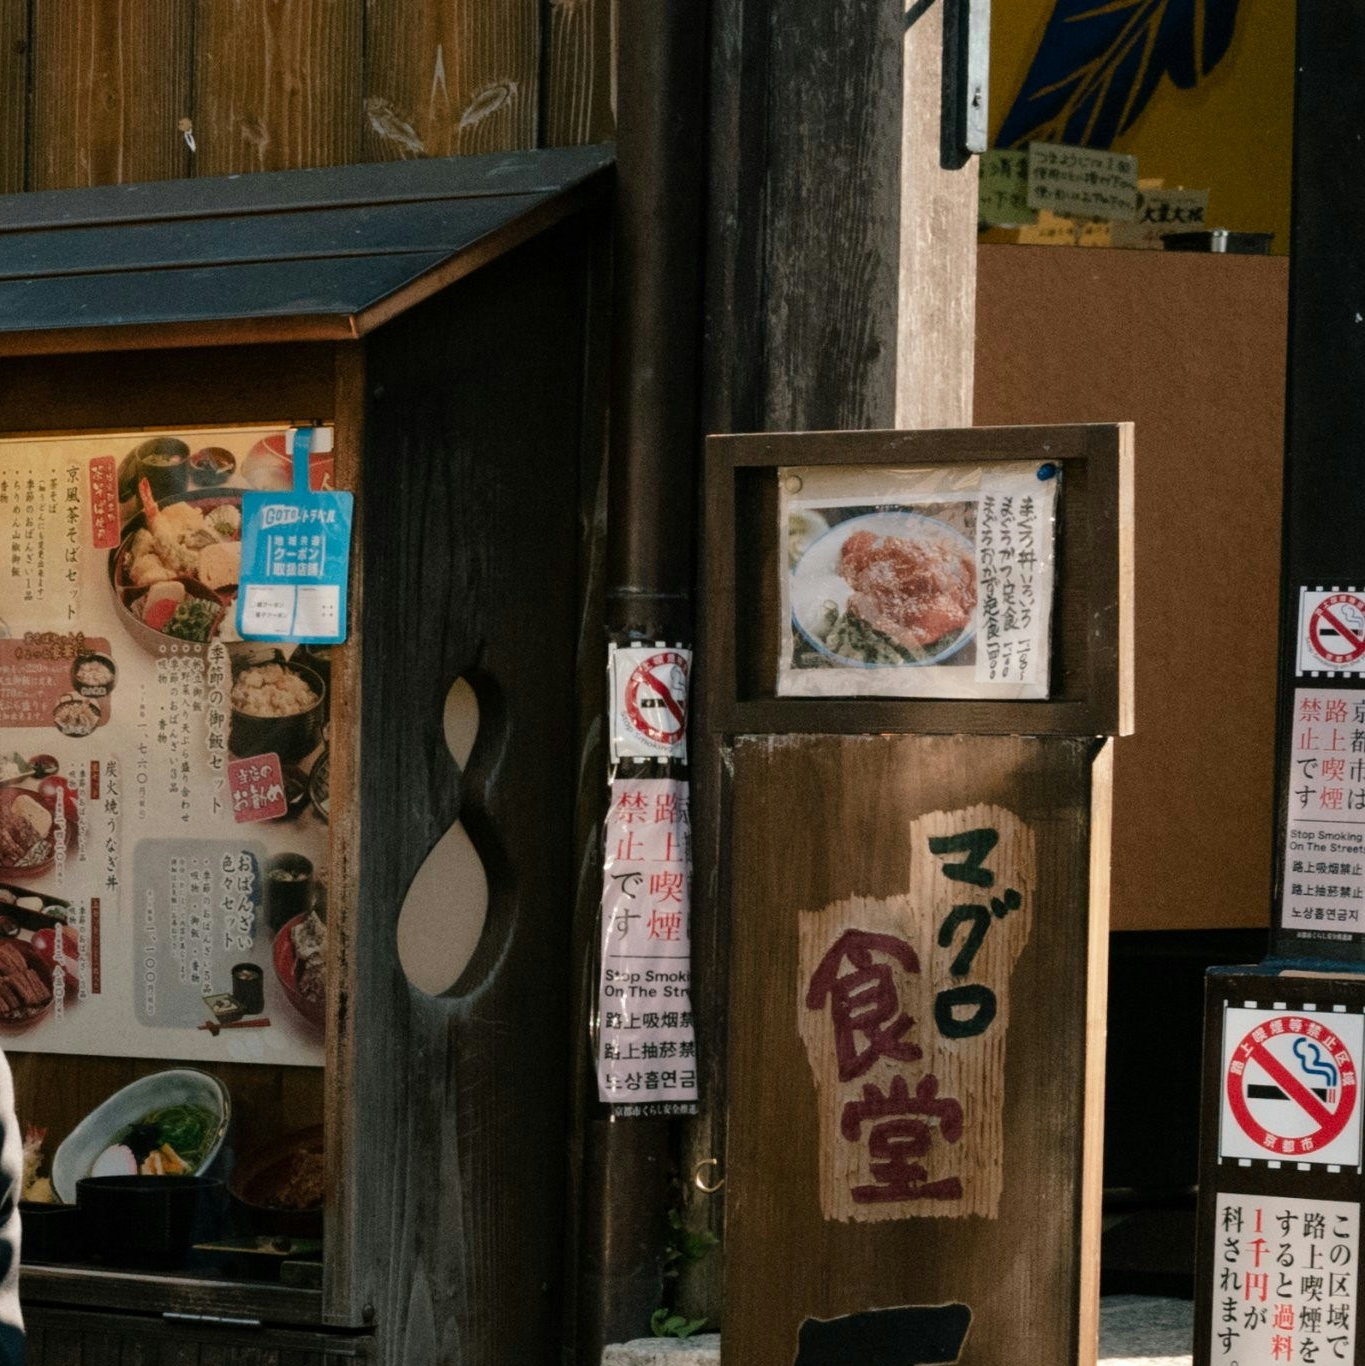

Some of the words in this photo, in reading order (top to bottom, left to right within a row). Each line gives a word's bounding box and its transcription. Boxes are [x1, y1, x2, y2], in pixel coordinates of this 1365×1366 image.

[65, 465, 80, 620] 京風茶そばセット
[273, 547, 320, 560] クーポン
[209, 644, 225, 814] 季節の御飯セット
[1295, 697, 1322, 809] 禁止です
[1319, 699, 1348, 811] 路上喫煙
[103, 761, 119, 890] 炭火焼うなぎ丼
[608, 791, 648, 941] 禁止です
[646, 793, 684, 942] 路上喫煙
[1289, 841, 1304, 851] On
[1307, 842, 1327, 852] The
[1290, 829, 1315, 840] Stop
[1318, 830, 1363, 843] Smoking
[221, 854, 237, 950] 色々セット
[237, 854, 253, 951] おばんざい
[928, 828, 1022, 1039] マグロ
[604, 984, 624, 998] On
[629, 984, 657, 998] The
[605, 969, 641, 984] Stop
[806, 928, 964, 1204] 食堂
[1263, 1133, 1314, 1153] 京都市
[1243, 1208, 1270, 1331] 1千円が
[1271, 1209, 1299, 1362] すると過料
[1299, 1212, 1326, 1364] 路上喫煙を
[1327, 1215, 1352, 1359] この区域で
